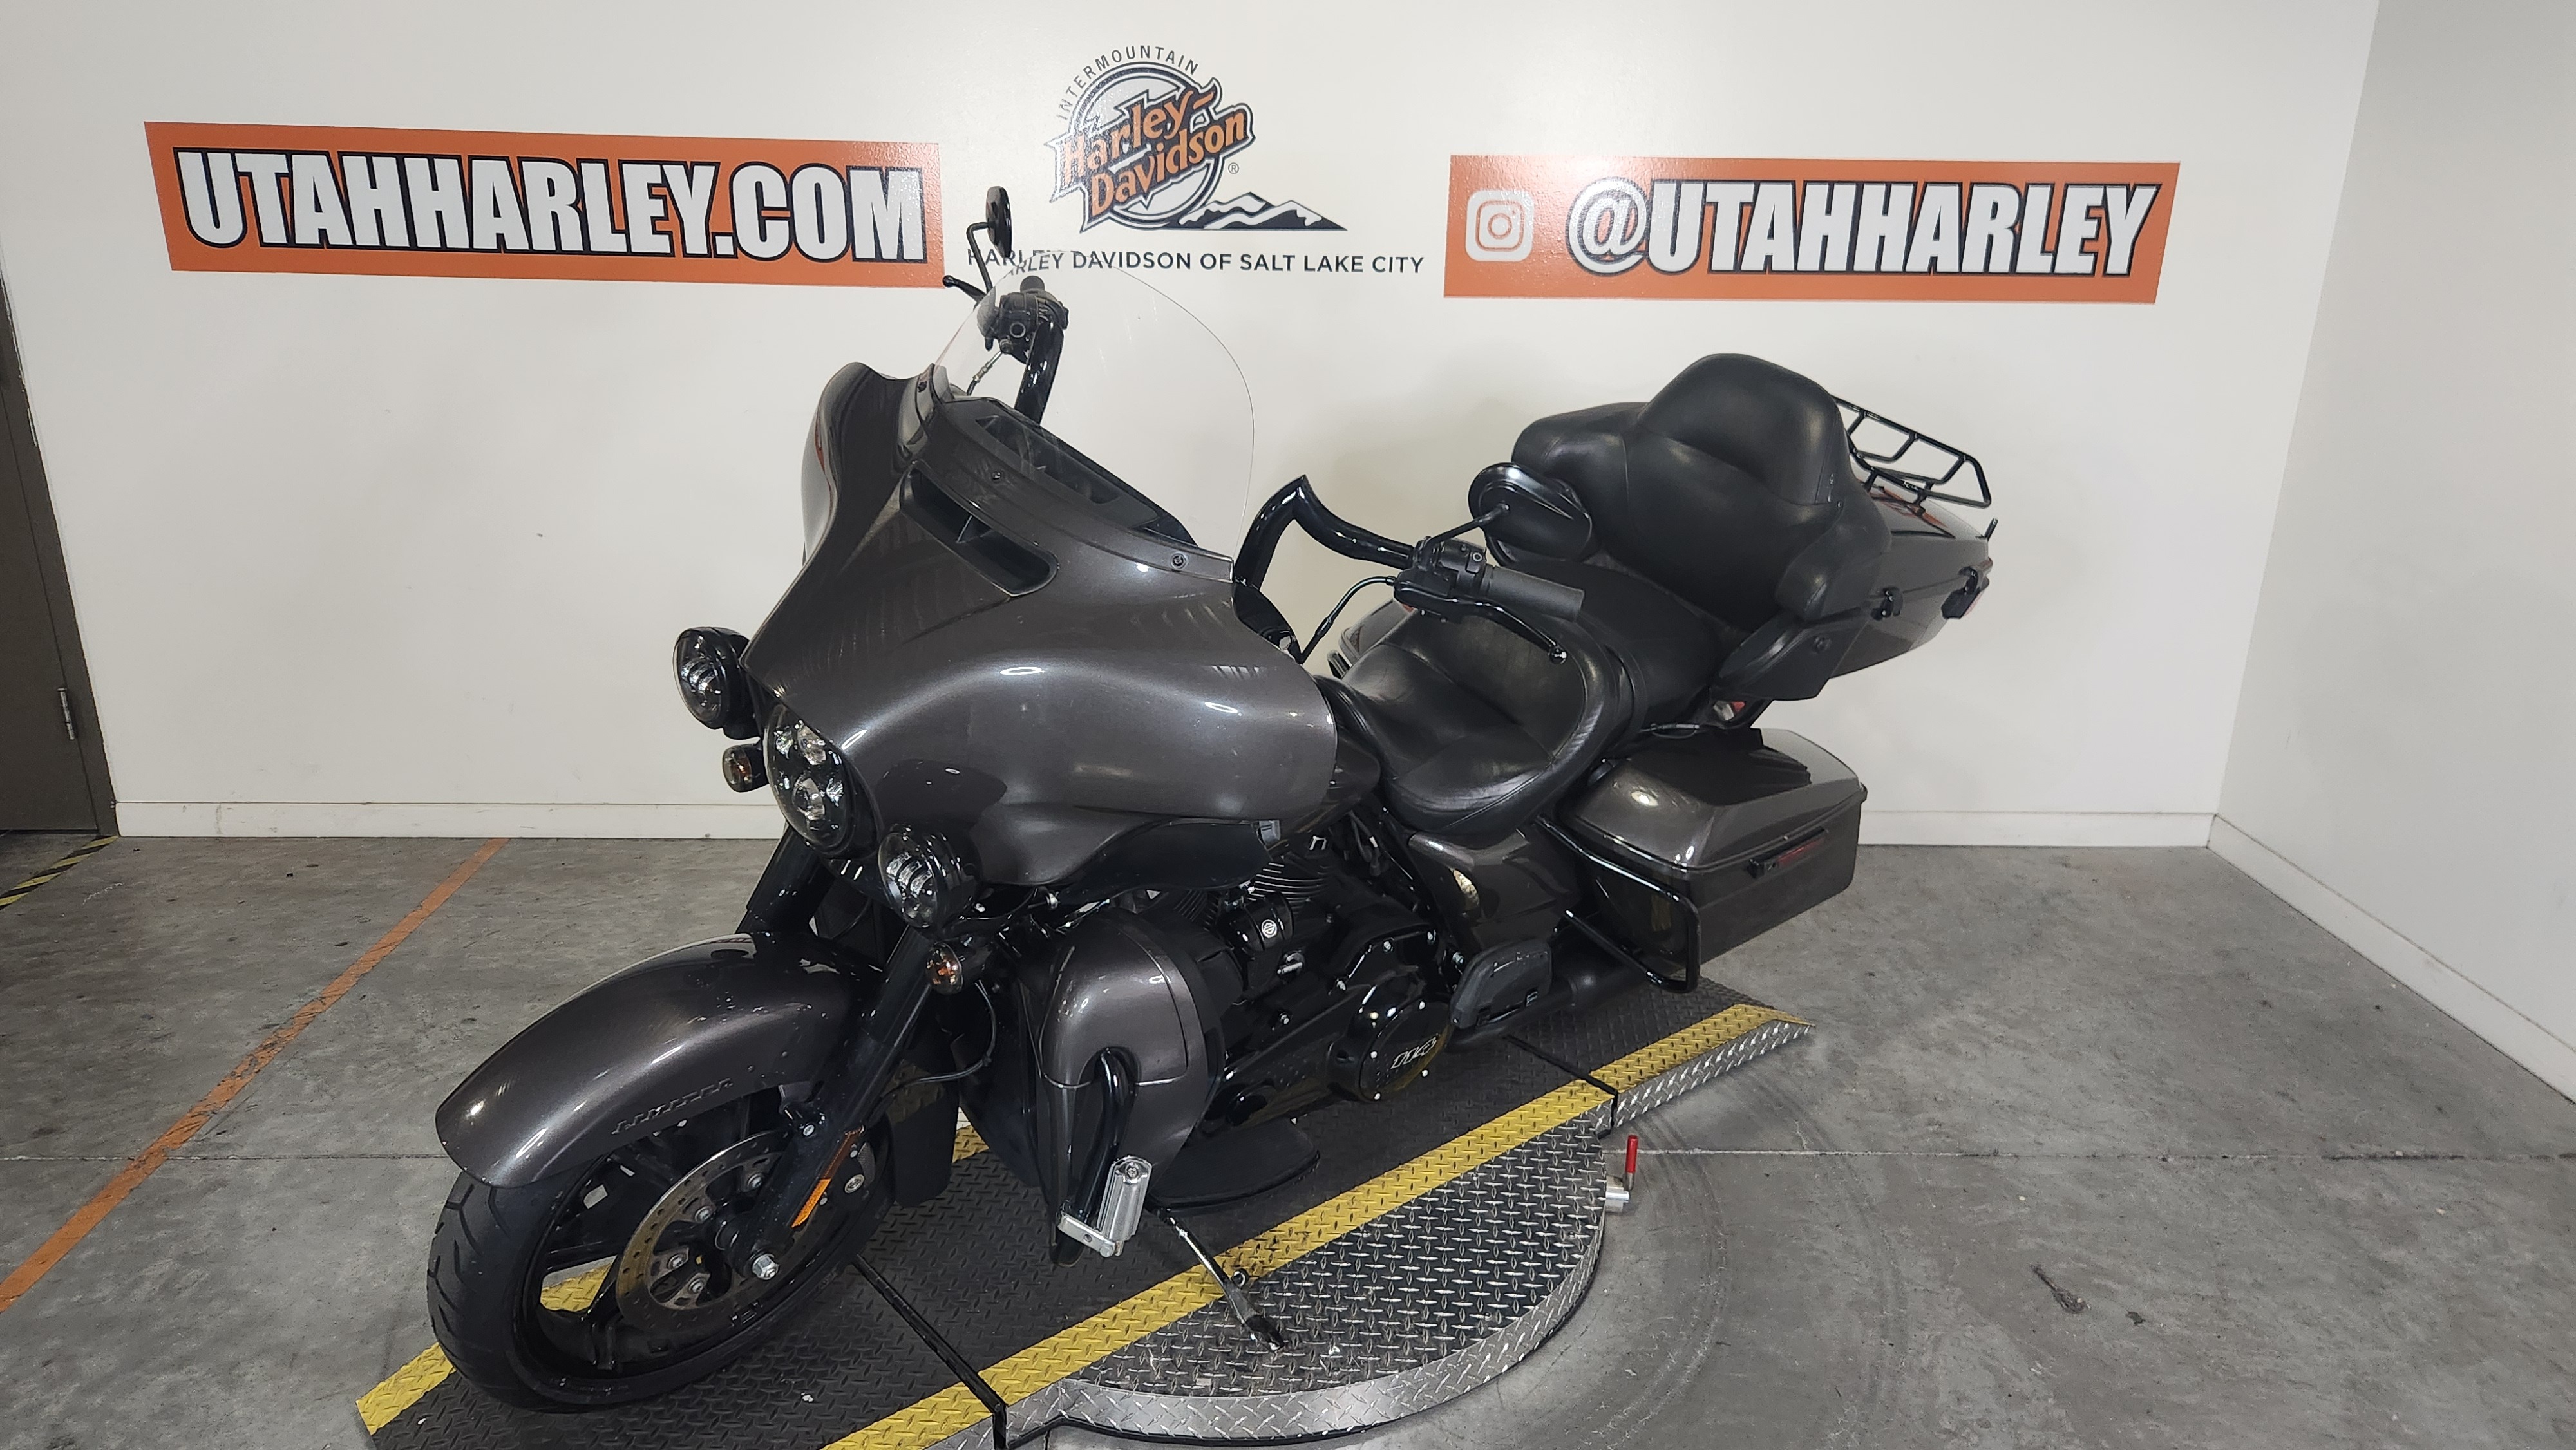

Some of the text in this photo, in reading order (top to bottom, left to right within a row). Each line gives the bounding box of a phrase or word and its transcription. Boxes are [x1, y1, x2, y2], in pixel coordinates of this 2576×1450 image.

[1056, 44, 1198, 121] INTERMOUNTAIN
[173, 146, 928, 264] UTAHHARLEY.COM
[1091, 111, 1245, 217] Davidson
[1071, 250, 1191, 270] DAVIDSON
[1200, 253, 1232, 270] OF
[1240, 254, 1296, 272] SALT
[1303, 255, 1364, 273] LAKE
[1372, 256, 1425, 274] CITY
[1566, 176, 2163, 278] @UTAHHARLEY
